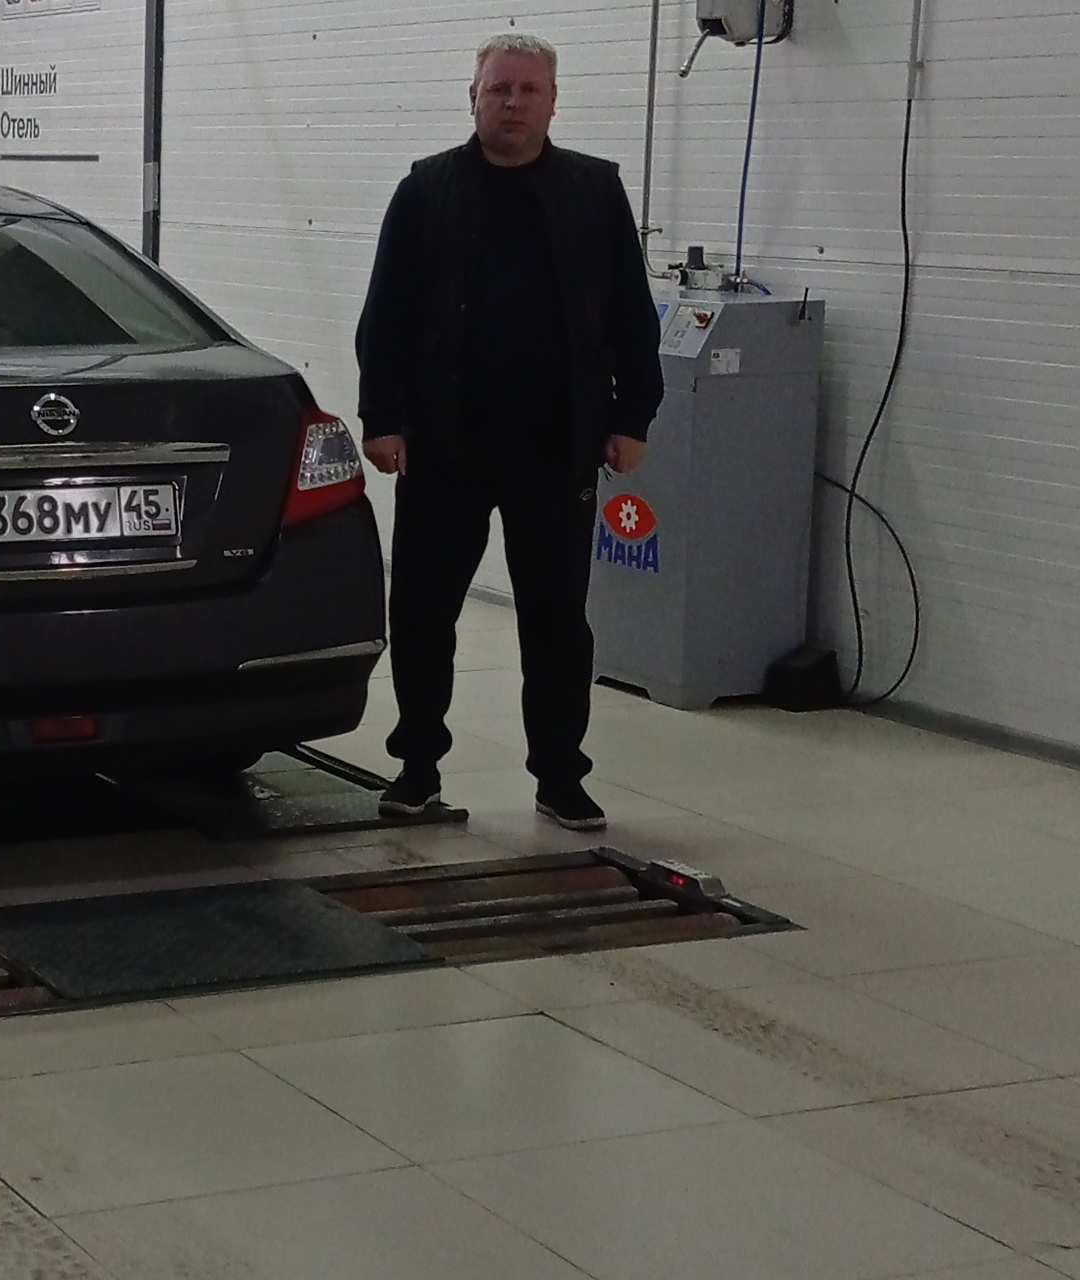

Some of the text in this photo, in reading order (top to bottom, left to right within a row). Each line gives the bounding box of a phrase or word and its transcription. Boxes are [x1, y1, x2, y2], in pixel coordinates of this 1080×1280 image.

[1, 64, 57, 96] Шинный
[0, 111, 40, 139] Отель
[123, 489, 161, 519] 45
[597, 521, 659, 573] MAHA
